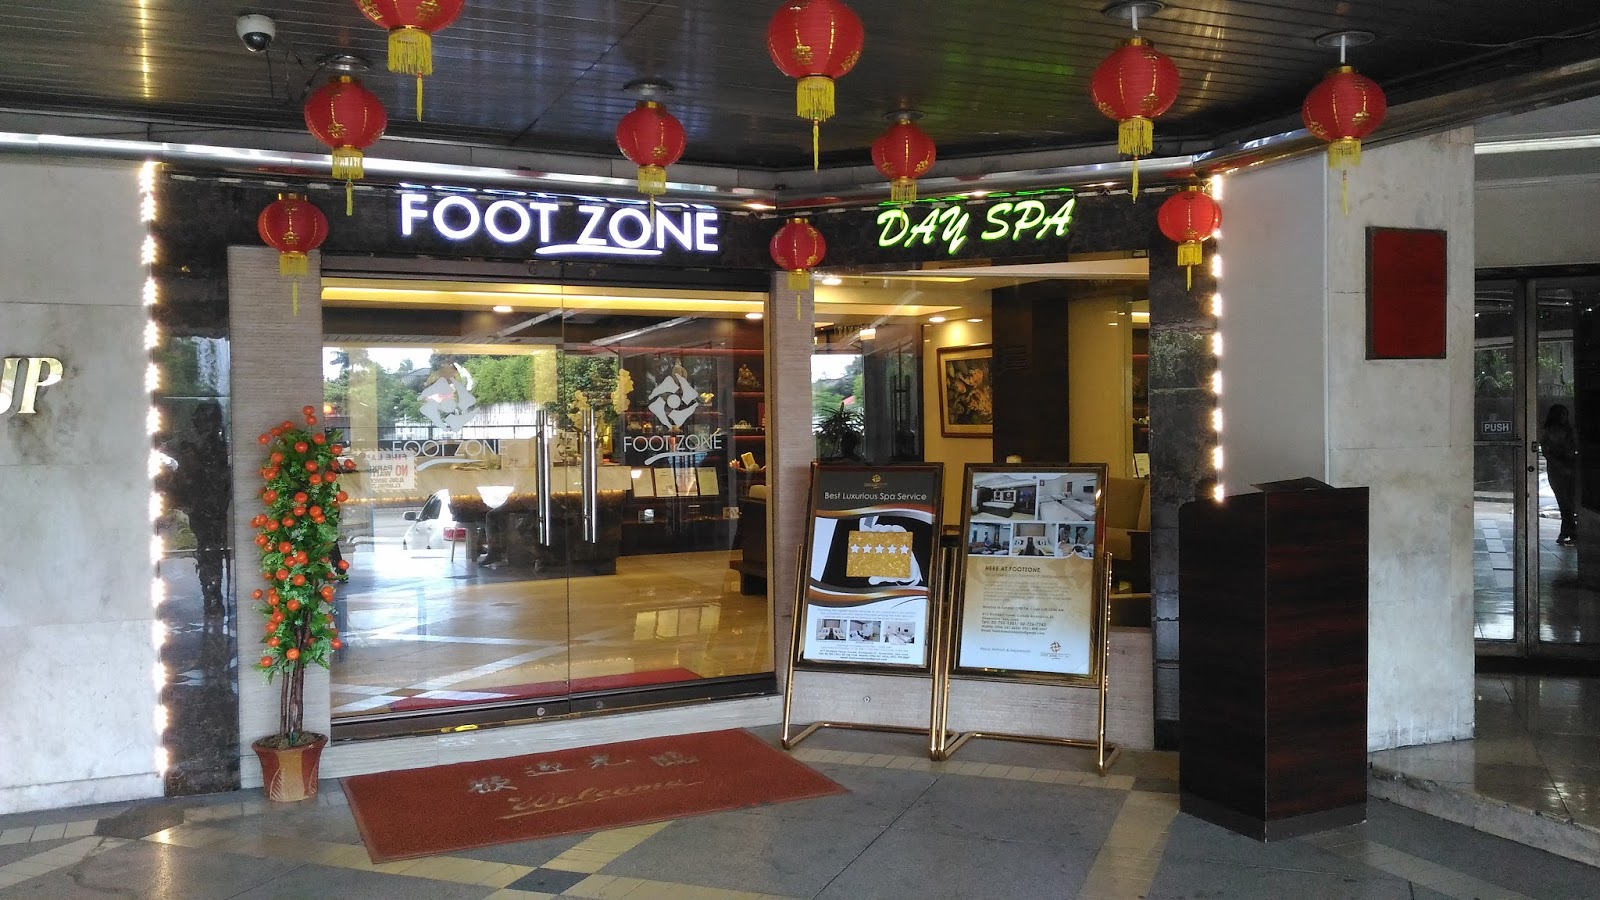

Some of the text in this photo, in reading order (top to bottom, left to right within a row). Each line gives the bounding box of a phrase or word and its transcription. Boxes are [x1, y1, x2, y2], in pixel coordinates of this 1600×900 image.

[401, 193, 719, 251] FOOT ZONE
[876, 198, 1076, 255] DAY SPA
[1484, 423, 1509, 432] PUSH
[392, 439, 508, 457] FOOT ZONE
[623, 434, 722, 452] FOOT ZONE
[824, 491, 927, 501] Best Luxurious Spa Service
